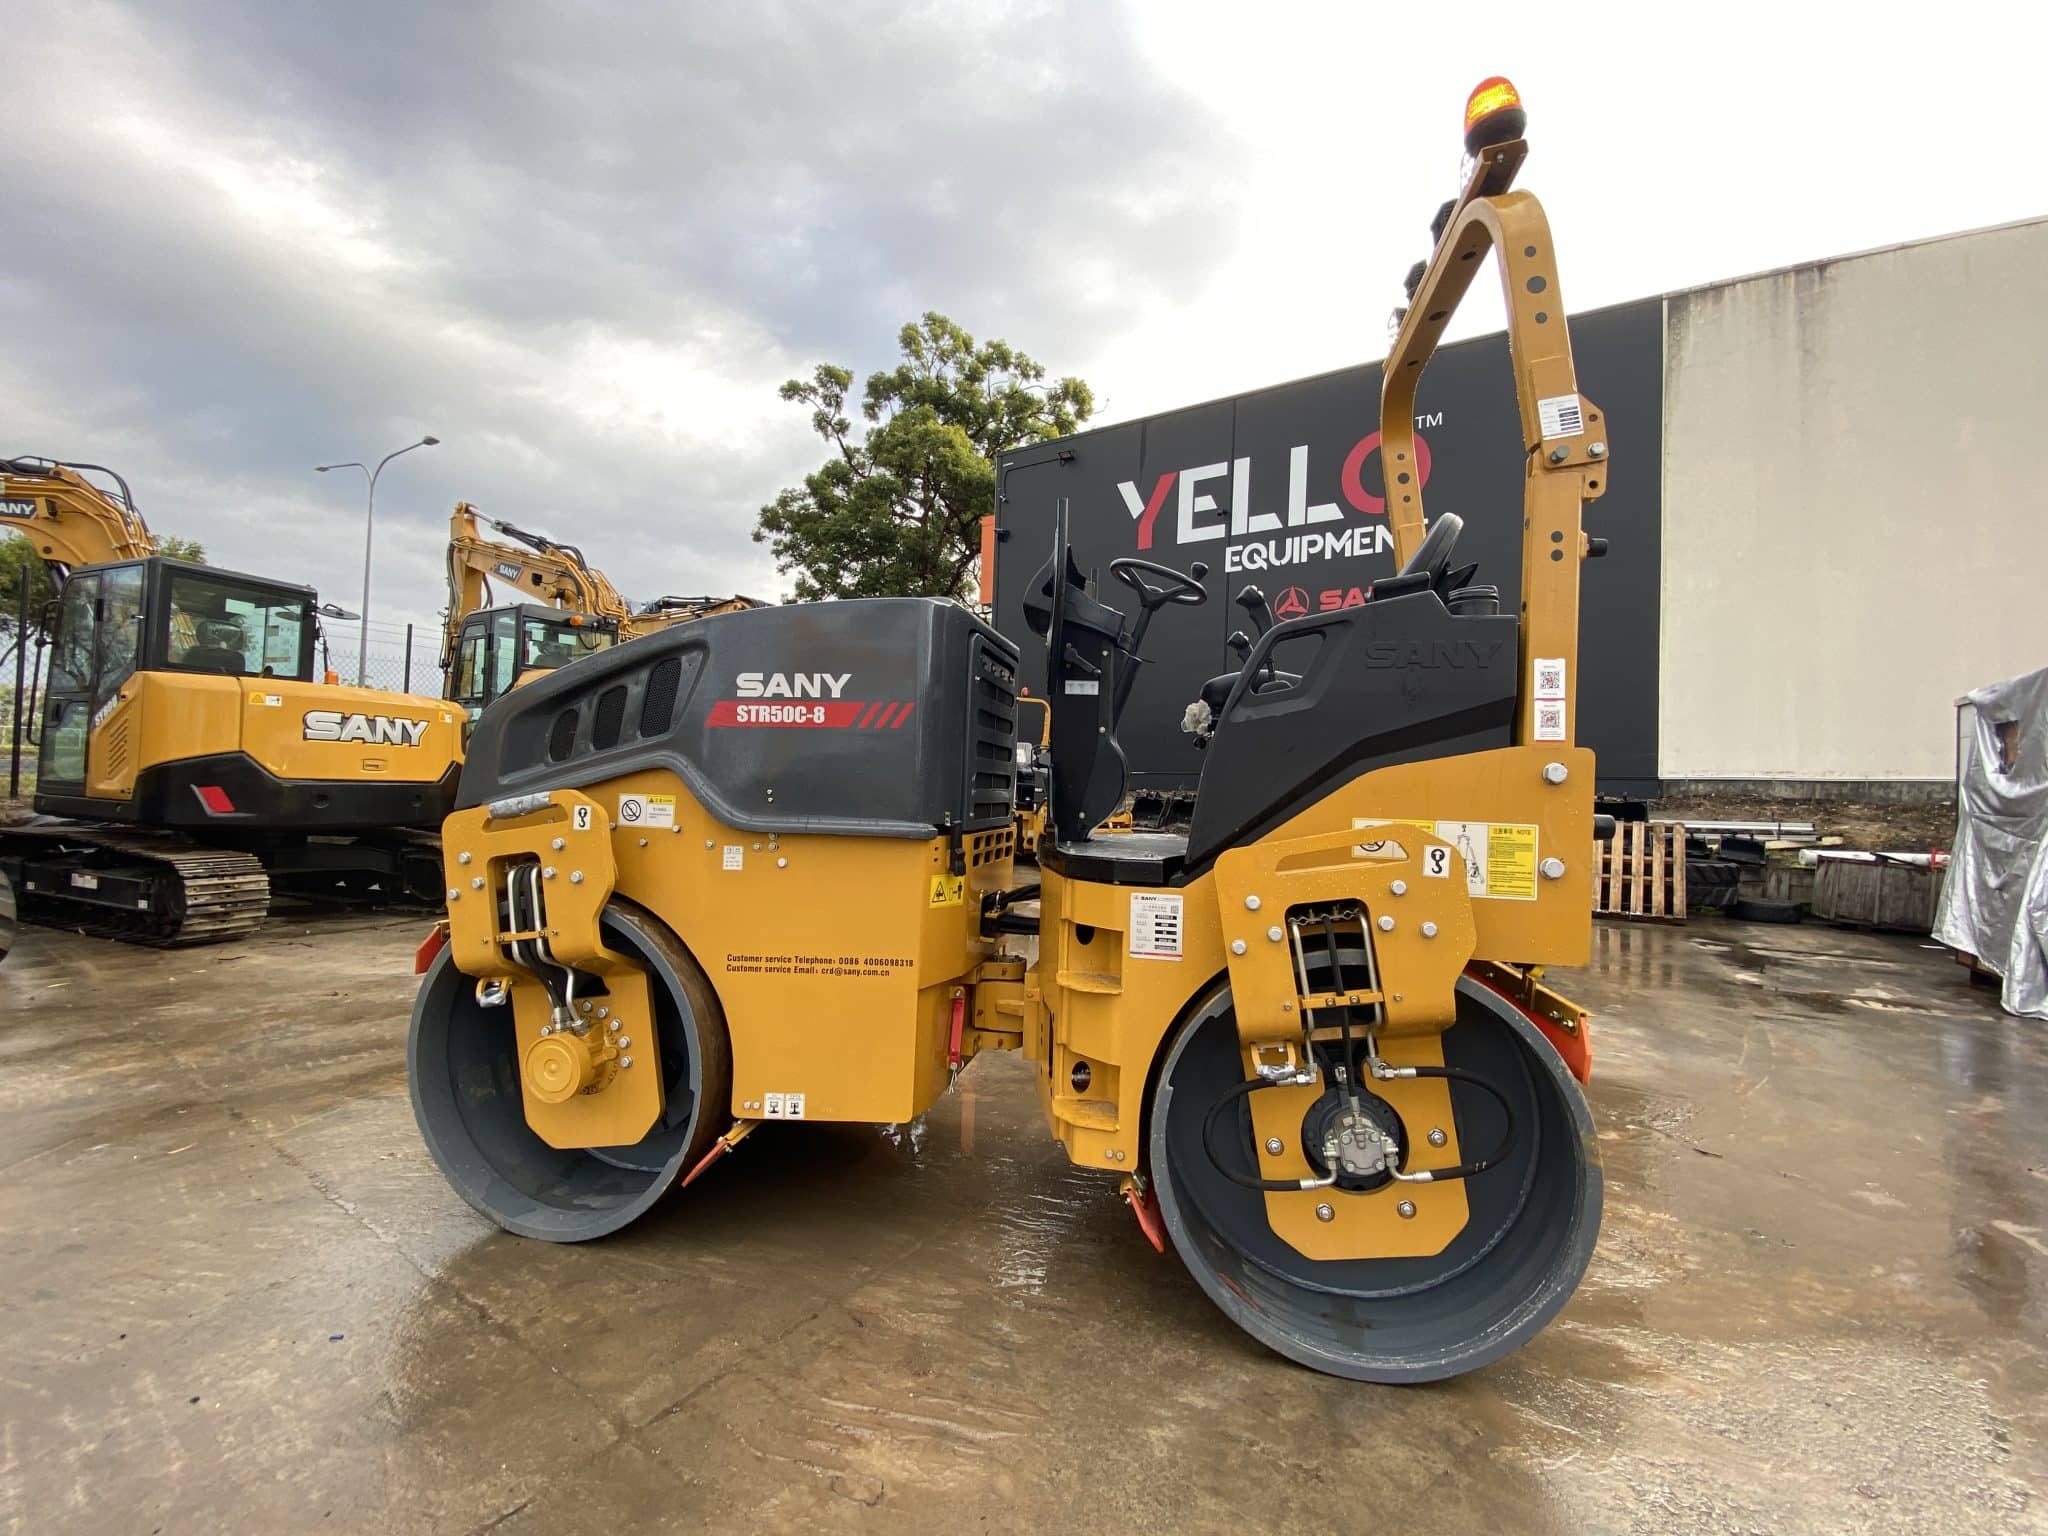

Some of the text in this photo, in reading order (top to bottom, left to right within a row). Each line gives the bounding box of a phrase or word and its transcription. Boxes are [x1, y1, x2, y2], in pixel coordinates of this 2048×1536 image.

[1415, 411, 1443, 430] TM
[1117, 430, 1431, 550] YELLO
[0, 502, 35, 515] ANY
[1225, 518, 1429, 573] EQUIPMEN
[1319, 585, 1375, 611] SA
[1366, 640, 1504, 669] SANY
[736, 672, 853, 698] SANY
[736, 705, 825, 723] STR50C-8
[303, 710, 430, 746] SANY
[726, 963, 763, 972] Customer
[764, 966, 792, 974] service
[821, 967, 890, 977] crd@sany.com.cn
[727, 953, 763, 963] Customer
[764, 955, 792, 964] service
[838, 956, 859, 965] 0086
